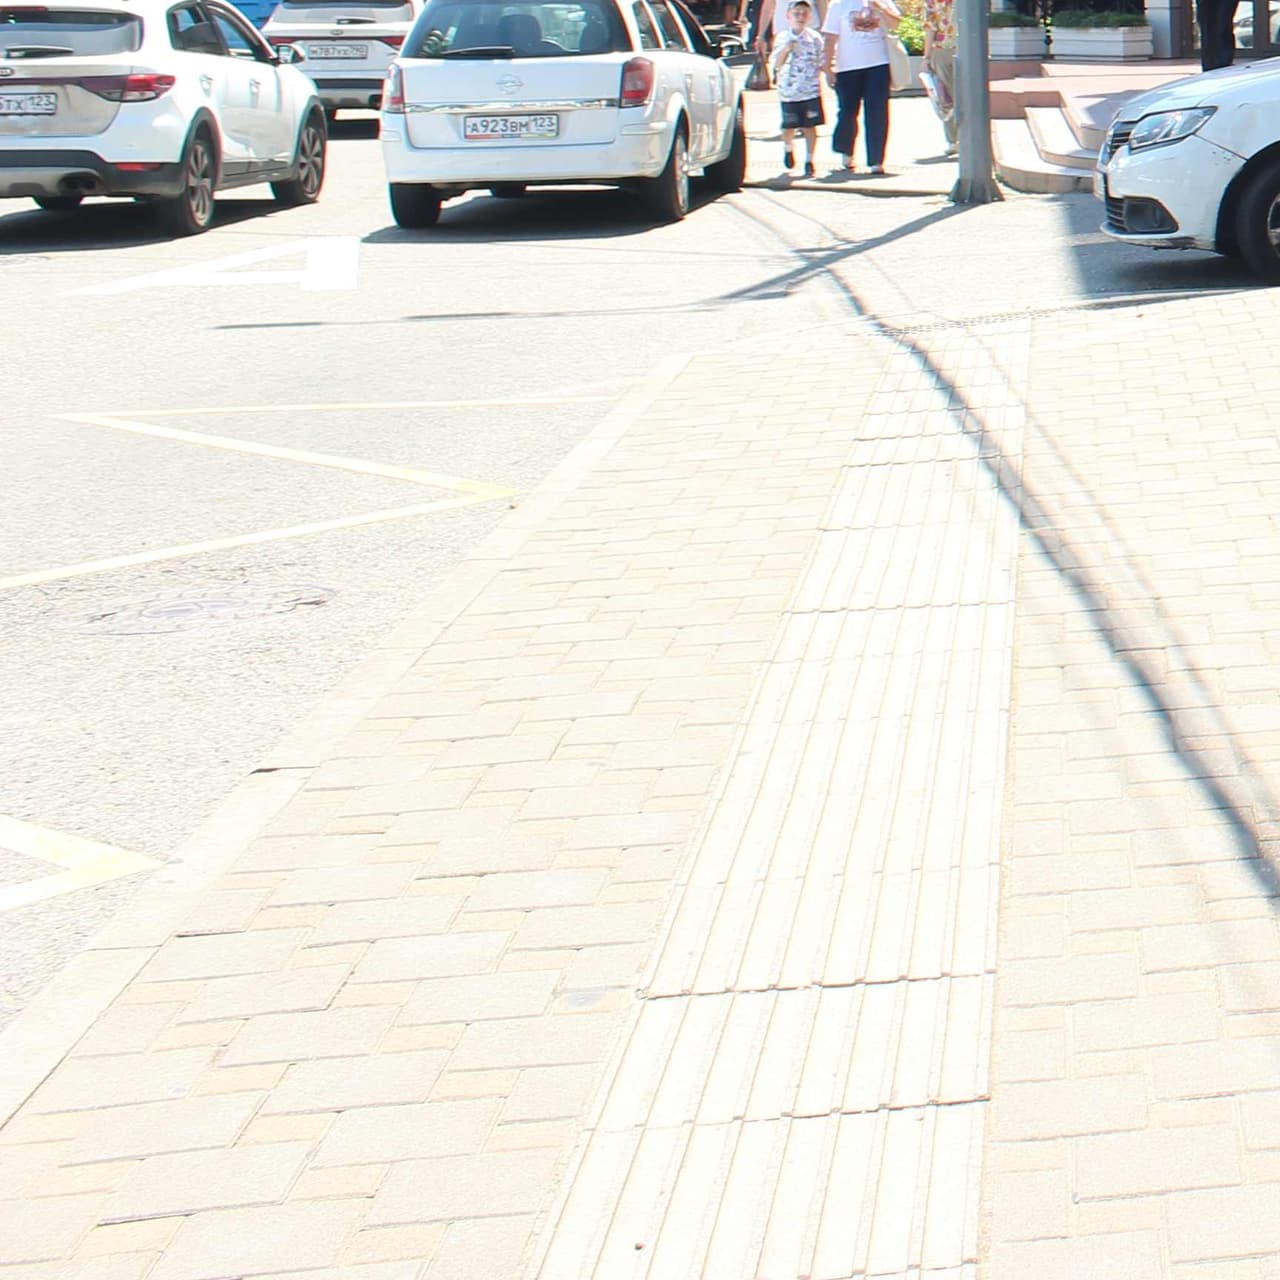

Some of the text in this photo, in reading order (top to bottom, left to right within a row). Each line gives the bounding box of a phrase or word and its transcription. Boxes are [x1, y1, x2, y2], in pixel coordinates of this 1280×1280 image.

[29, 95, 52, 105] 123
[469, 116, 554, 134] А923ВМ 123
